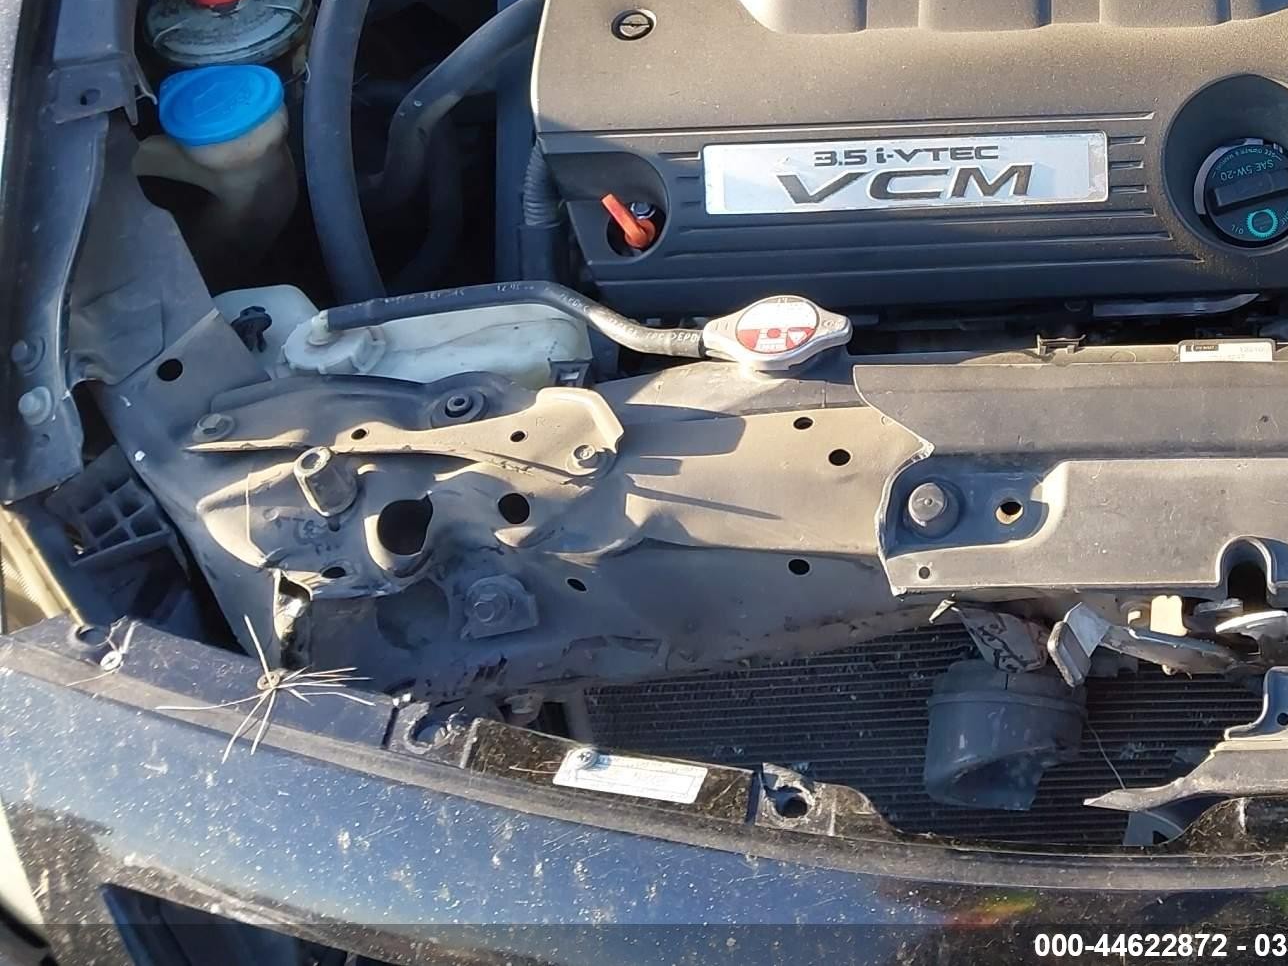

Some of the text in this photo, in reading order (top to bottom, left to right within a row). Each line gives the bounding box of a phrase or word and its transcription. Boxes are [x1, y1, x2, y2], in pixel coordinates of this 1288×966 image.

[814, 146, 999, 166] 3.5 i-VTEC
[1220, 159, 1274, 181] SAE 5W-20
[776, 164, 1034, 204] VCM
